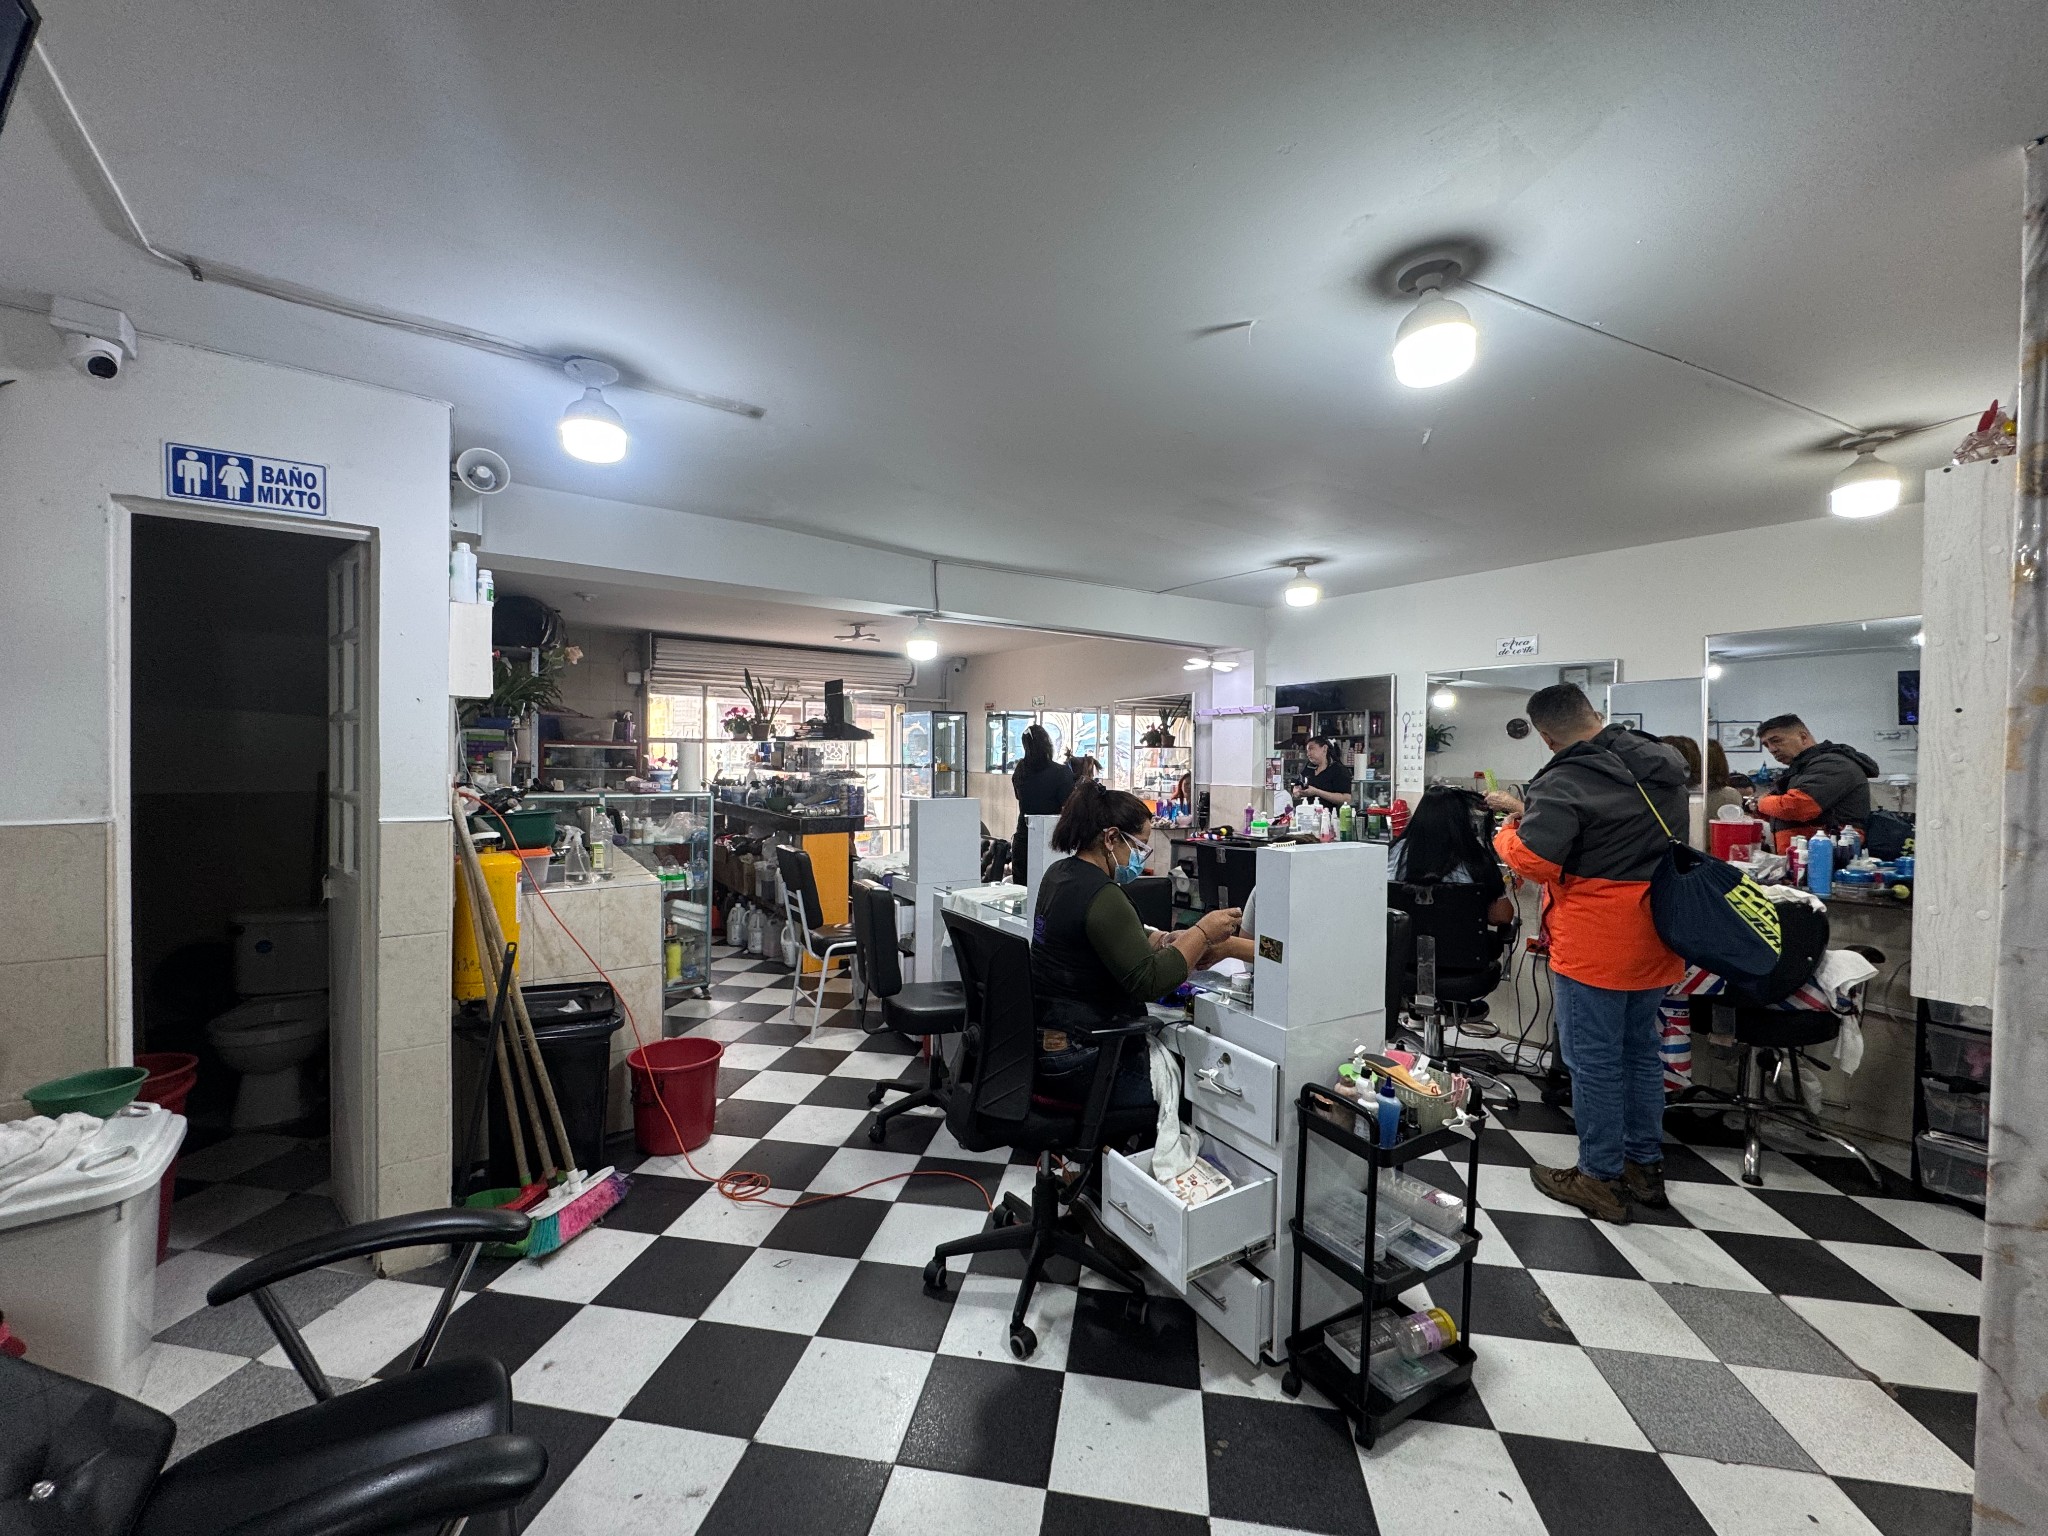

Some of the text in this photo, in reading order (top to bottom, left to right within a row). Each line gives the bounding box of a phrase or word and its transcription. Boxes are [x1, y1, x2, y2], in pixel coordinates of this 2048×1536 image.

[261, 465, 317, 490] BAÑO
[257, 485, 321, 510] MIXTO
[1498, 646, 1535, 656] de corte
